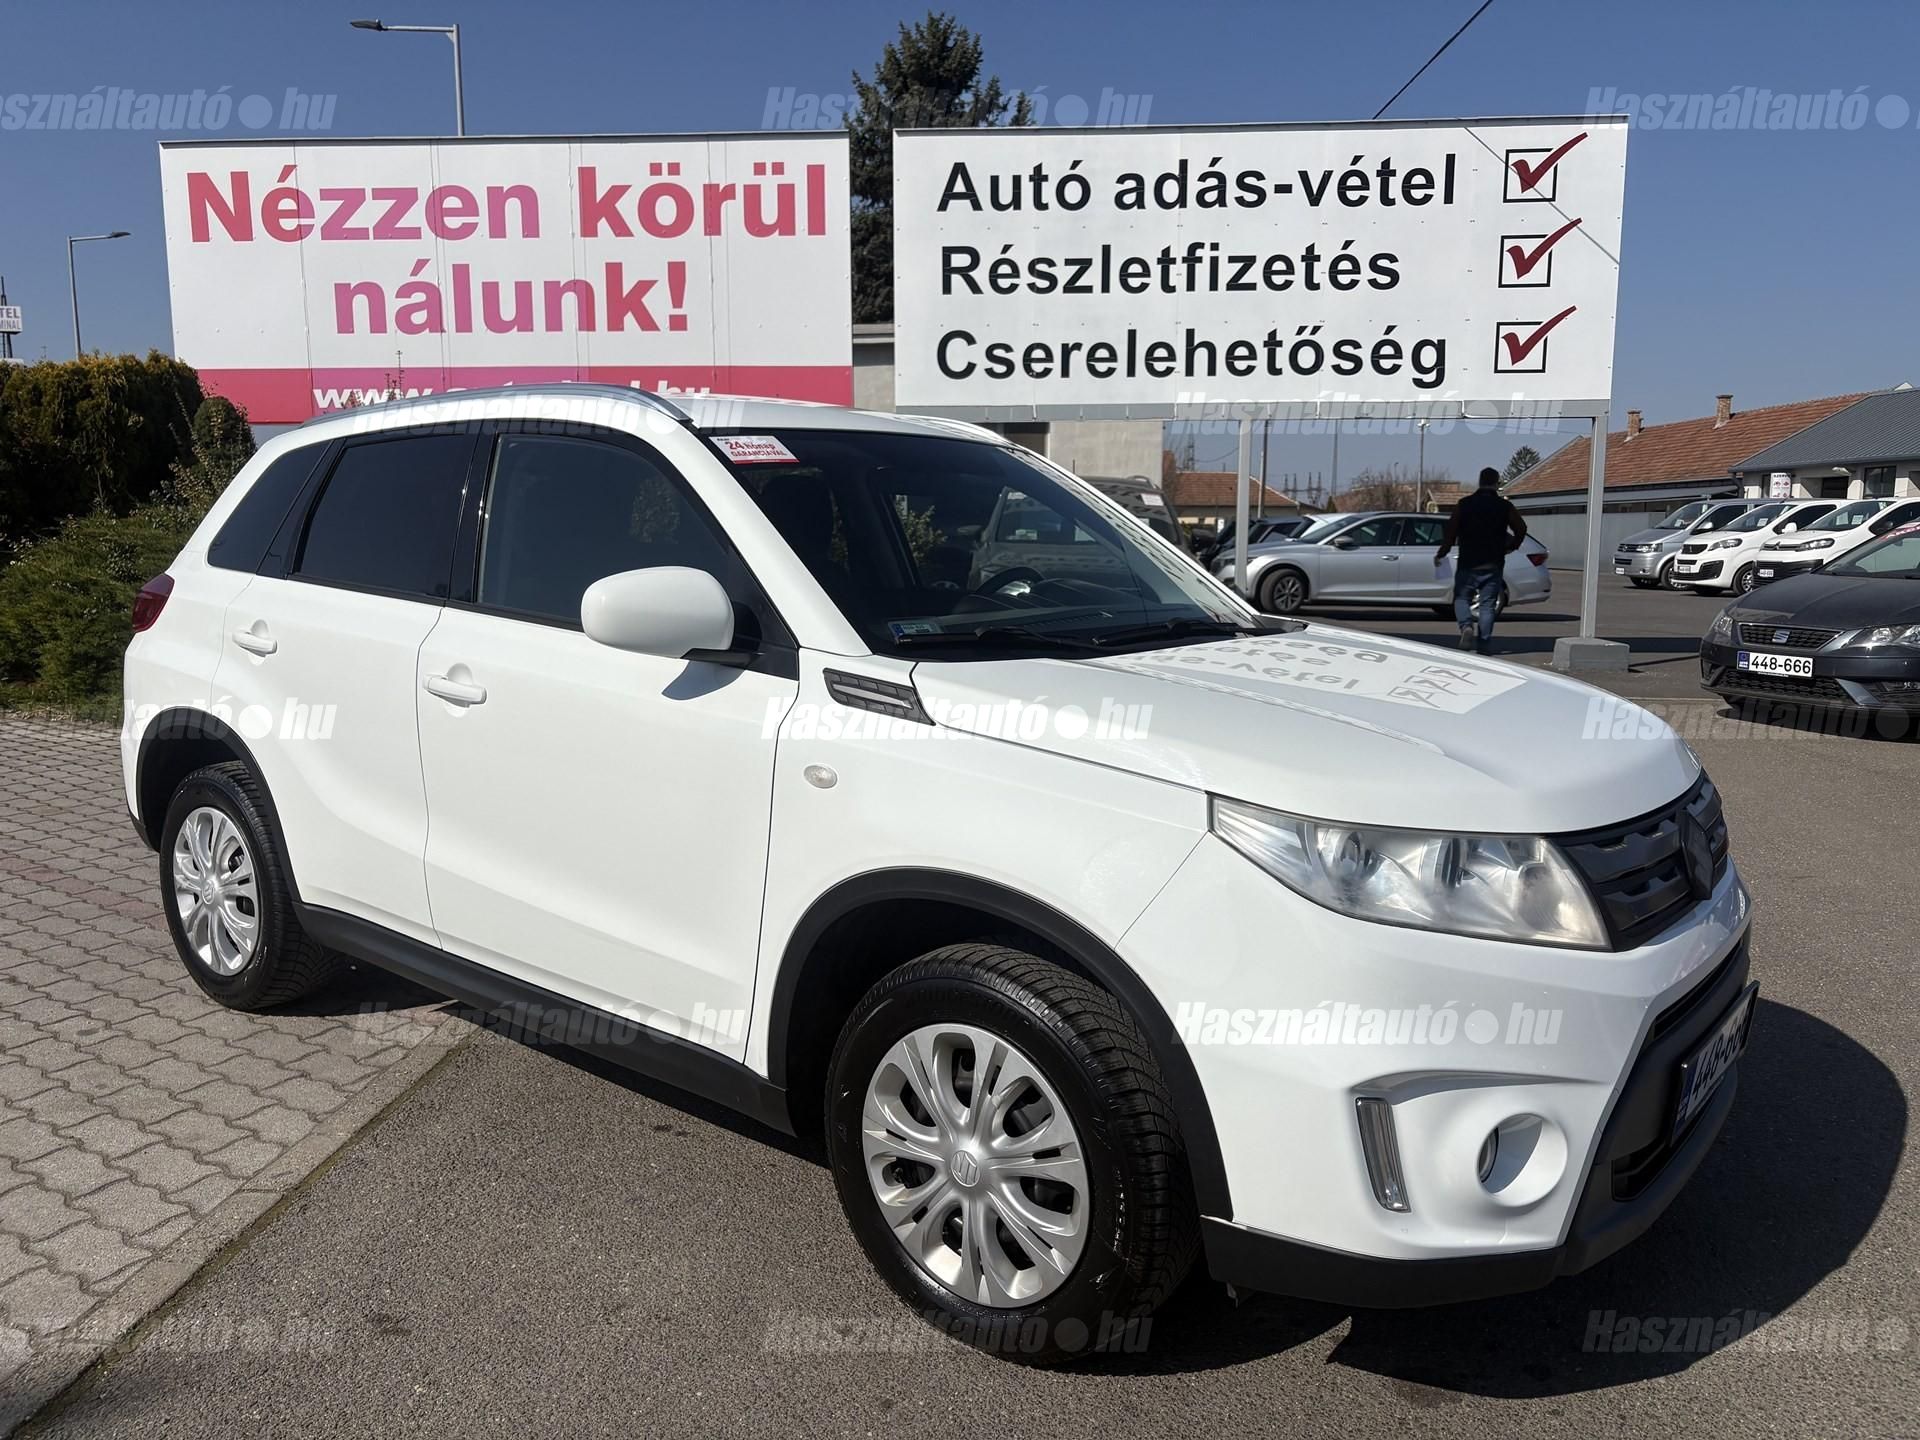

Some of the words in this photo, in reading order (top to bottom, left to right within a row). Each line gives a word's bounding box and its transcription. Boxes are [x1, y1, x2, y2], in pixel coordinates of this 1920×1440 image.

[188, 165, 538, 243] Nézzen
[579, 162, 826, 238] körül
[938, 159, 1091, 212] Autó
[1115, 153, 1456, 211] adás-vétel
[336, 260, 688, 335] nálunk!
[942, 239, 1400, 296] Részletfizetés
[938, 324, 1446, 389] Cserelehetőség
[1751, 655, 1811, 674] 448-666
